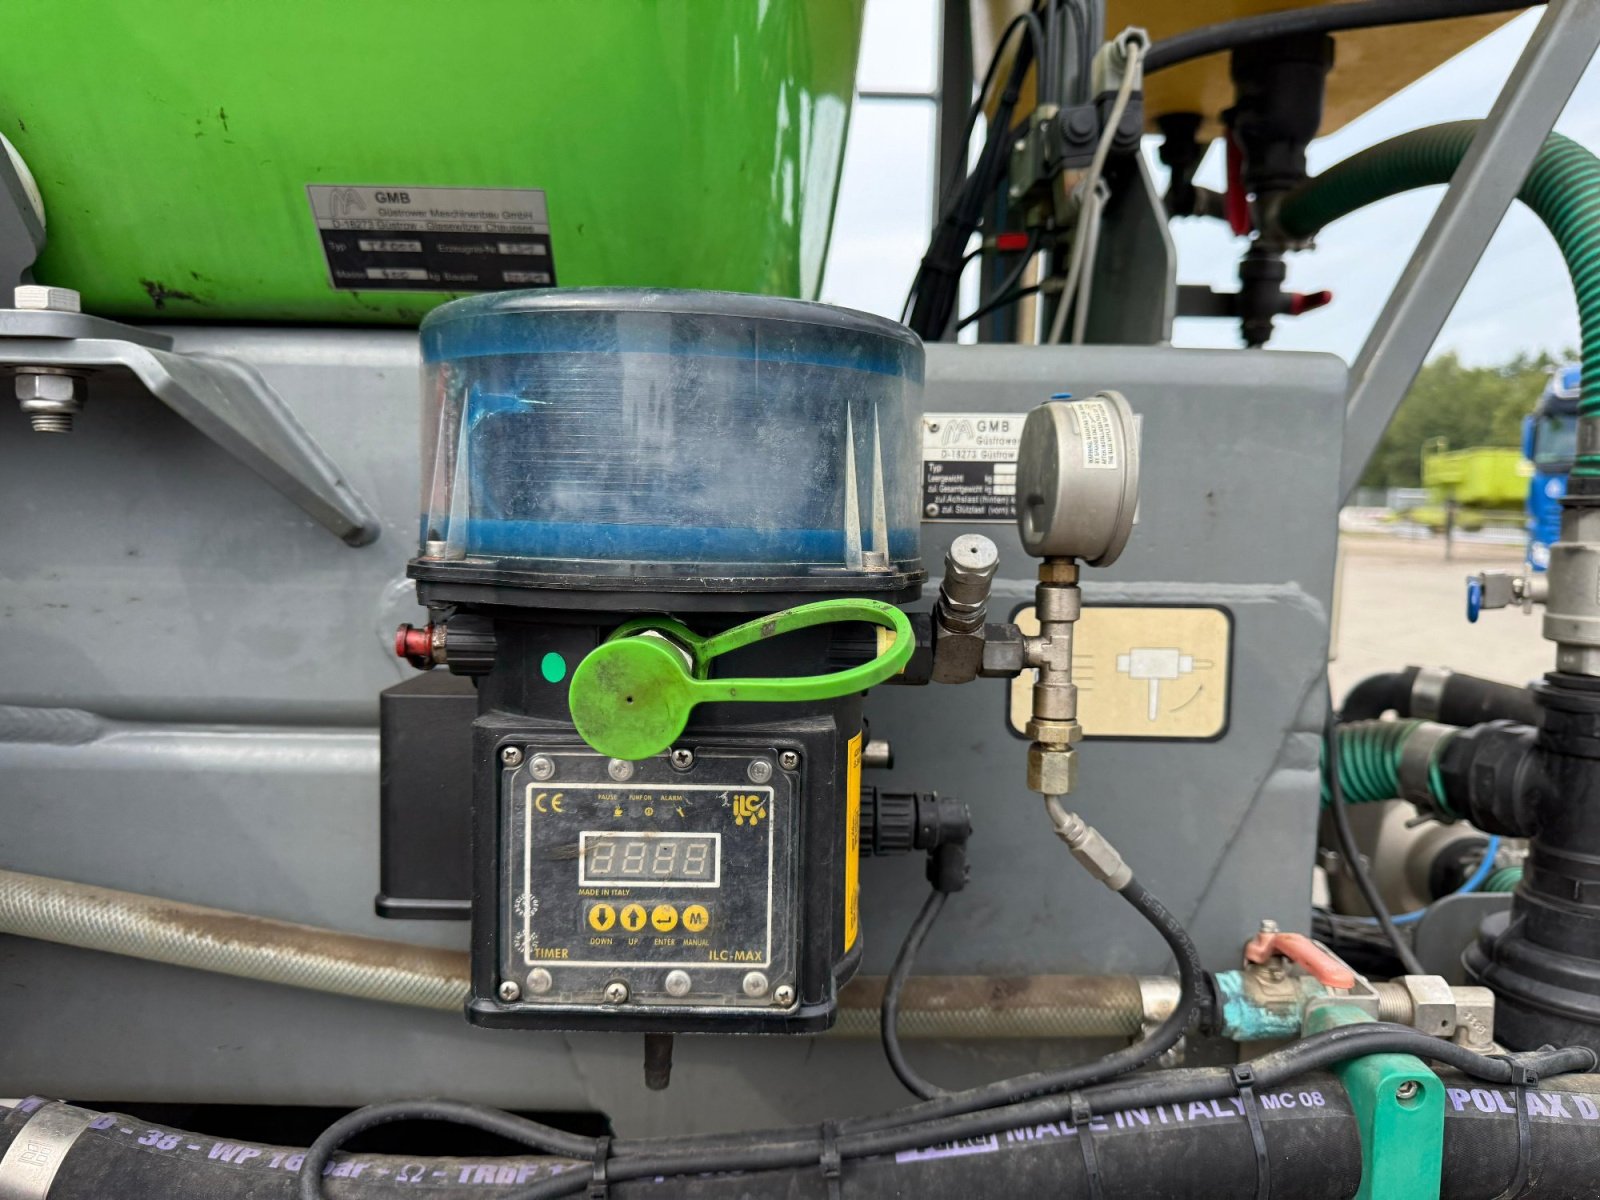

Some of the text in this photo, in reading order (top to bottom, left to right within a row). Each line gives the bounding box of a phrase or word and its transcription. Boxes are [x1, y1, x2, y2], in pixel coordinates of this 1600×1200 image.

[375, 191, 411, 204] GMB
[977, 421, 1010, 432] GMB
[976, 436, 1020, 445] Güstrowe
[928, 463, 943, 473] Typ
[578, 888, 630, 897] MADE IN ITALY
[590, 937, 709, 947] DOWN UP ENTER MANUAL
[534, 948, 569, 959] TIMER
[708, 950, 762, 961] ILC-MAX
[1259, 1093, 1296, 1110] MC
[1299, 1091, 1326, 1107] 08
[1446, 1088, 1573, 1119] POLAX
[138, 1130, 183, 1150] 38
[208, 1142, 261, 1164] WP
[268, 1152, 307, 1171] 16
[458, 1164, 538, 1184] TRbF
